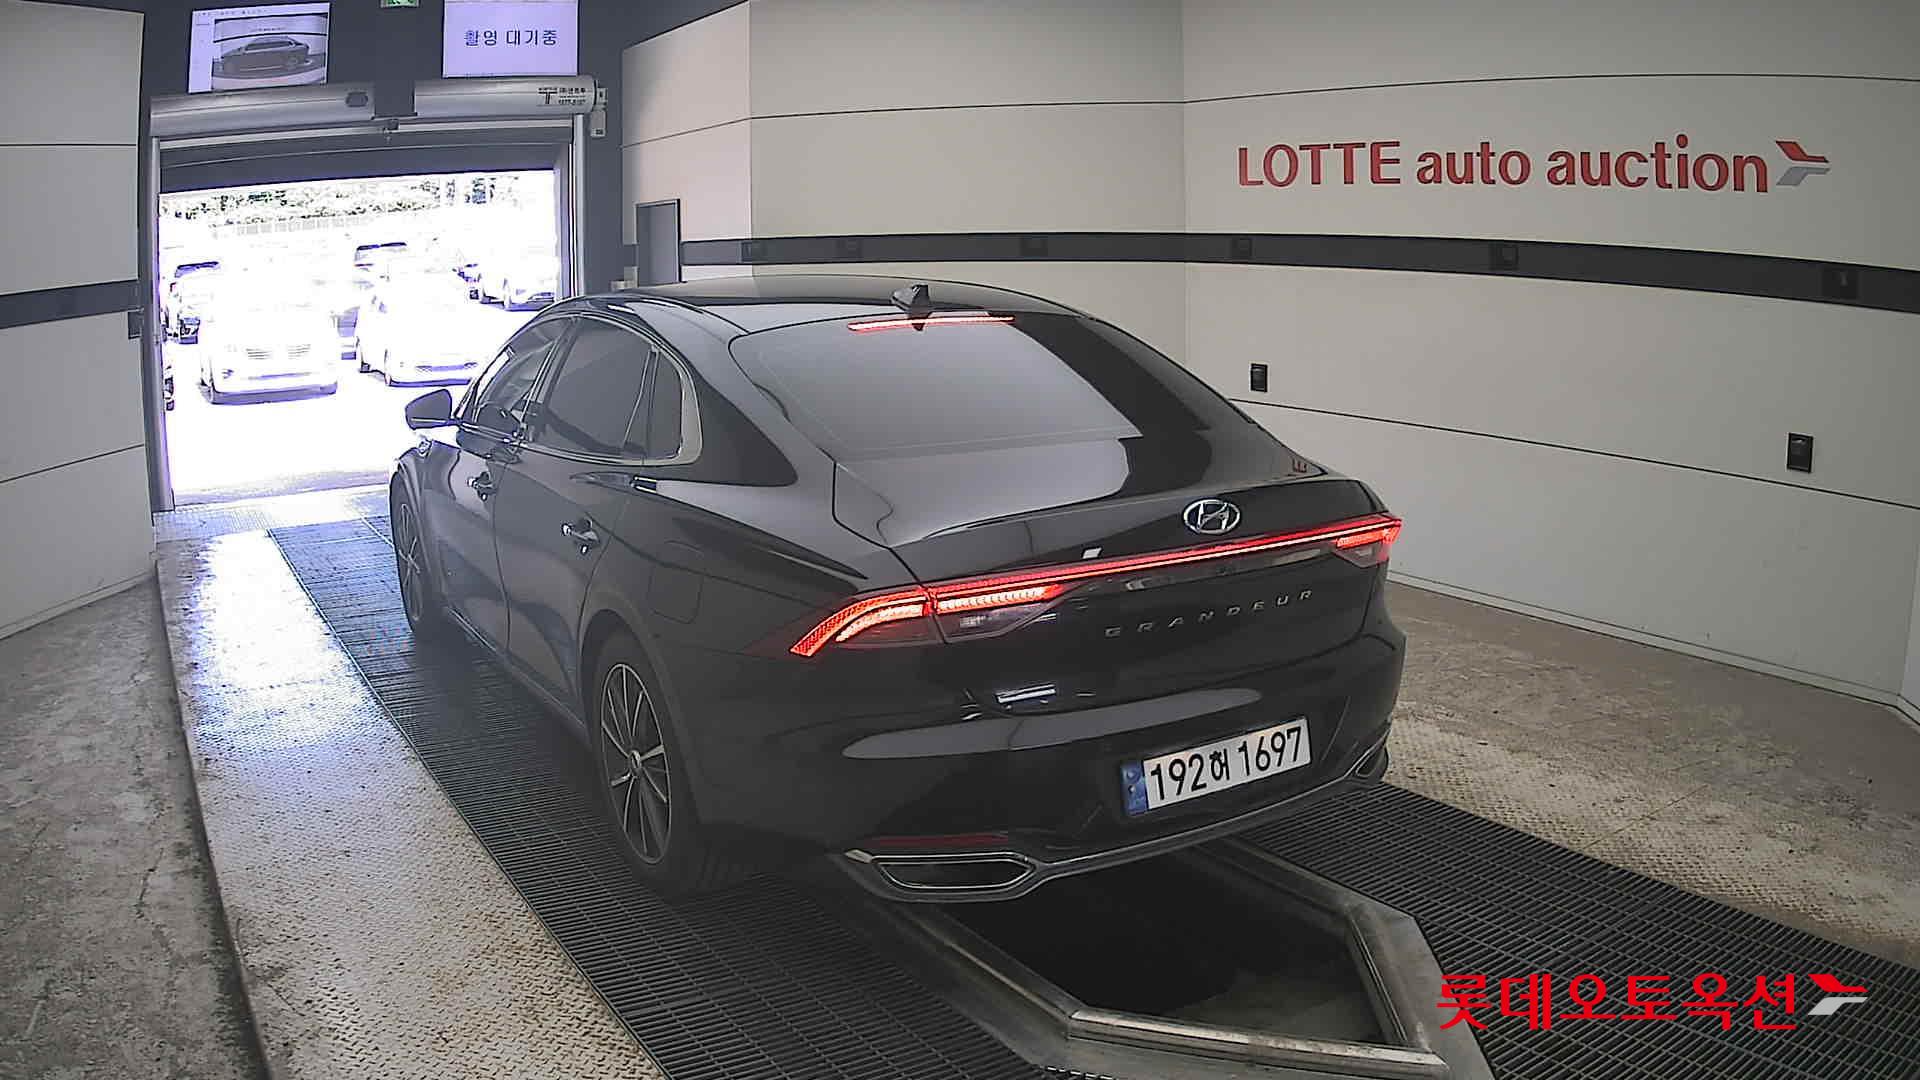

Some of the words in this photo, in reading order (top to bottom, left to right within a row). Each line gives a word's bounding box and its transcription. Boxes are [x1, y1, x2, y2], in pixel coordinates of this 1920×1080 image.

[506, 29, 558, 46] 대기중
[1238, 141, 1400, 187] LOTTE
[1417, 141, 1531, 185] auto
[1546, 135, 1769, 192] auction
[1104, 589, 1313, 638] GRANDEUR
[1150, 748, 1231, 801] 192허
[1237, 726, 1302, 777] 1697
